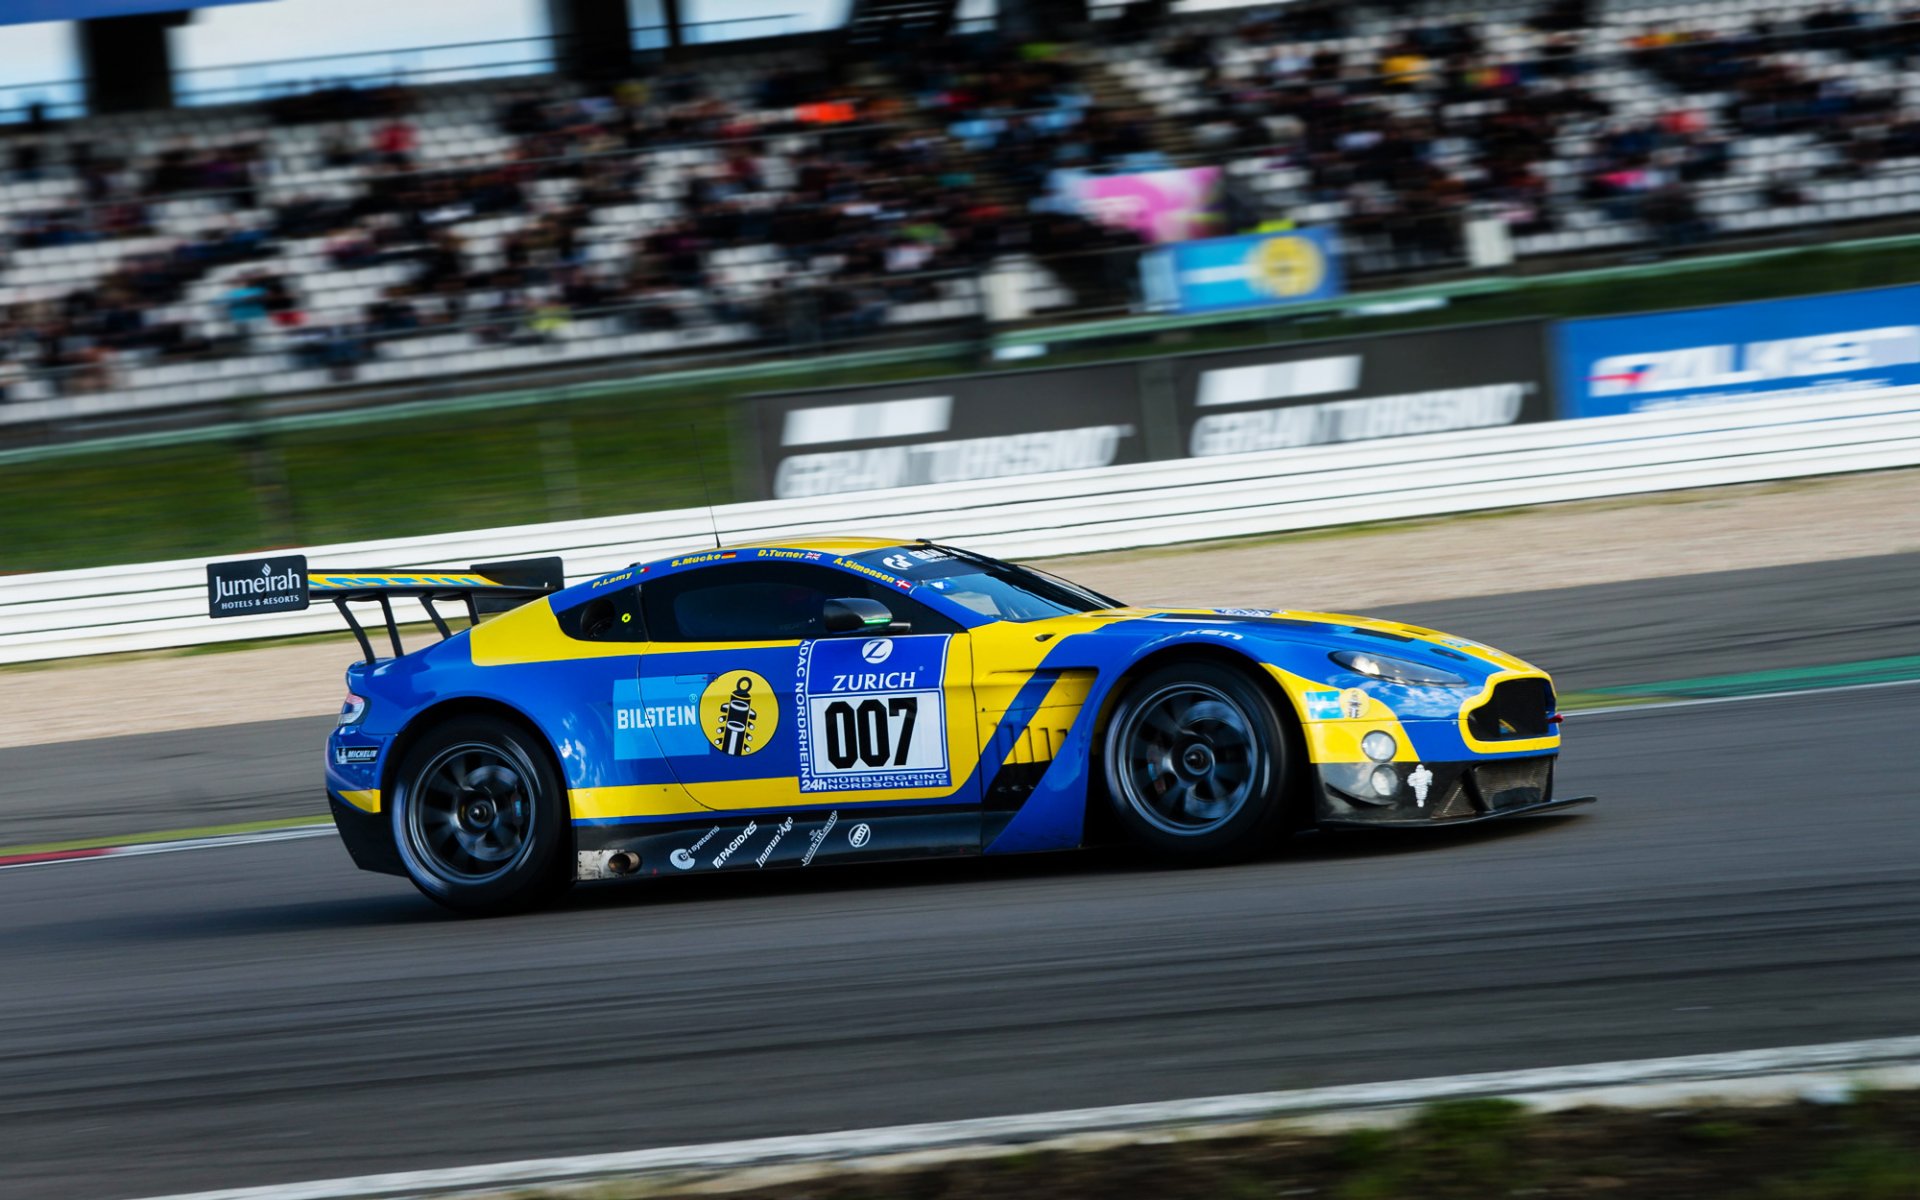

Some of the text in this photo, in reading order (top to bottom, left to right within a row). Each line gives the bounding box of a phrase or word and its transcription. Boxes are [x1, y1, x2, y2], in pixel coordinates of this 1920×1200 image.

[214, 566, 301, 604] Jumeirah
[592, 572, 633, 589] P.Lamy
[221, 599, 253, 610] HOTELS
[263, 595, 300, 605] RESORTS
[832, 672, 916, 692] ZURICH
[617, 705, 697, 729] BILSTEIN
[795, 640, 811, 778] ADAC NORDRHEIN
[824, 697, 918, 770] 007
[347, 749, 378, 758] MICHELIN
[801, 778, 827, 791] 24h
[827, 779, 949, 790] NORDSCHLEIFE
[719, 834, 746, 861] PAGID
